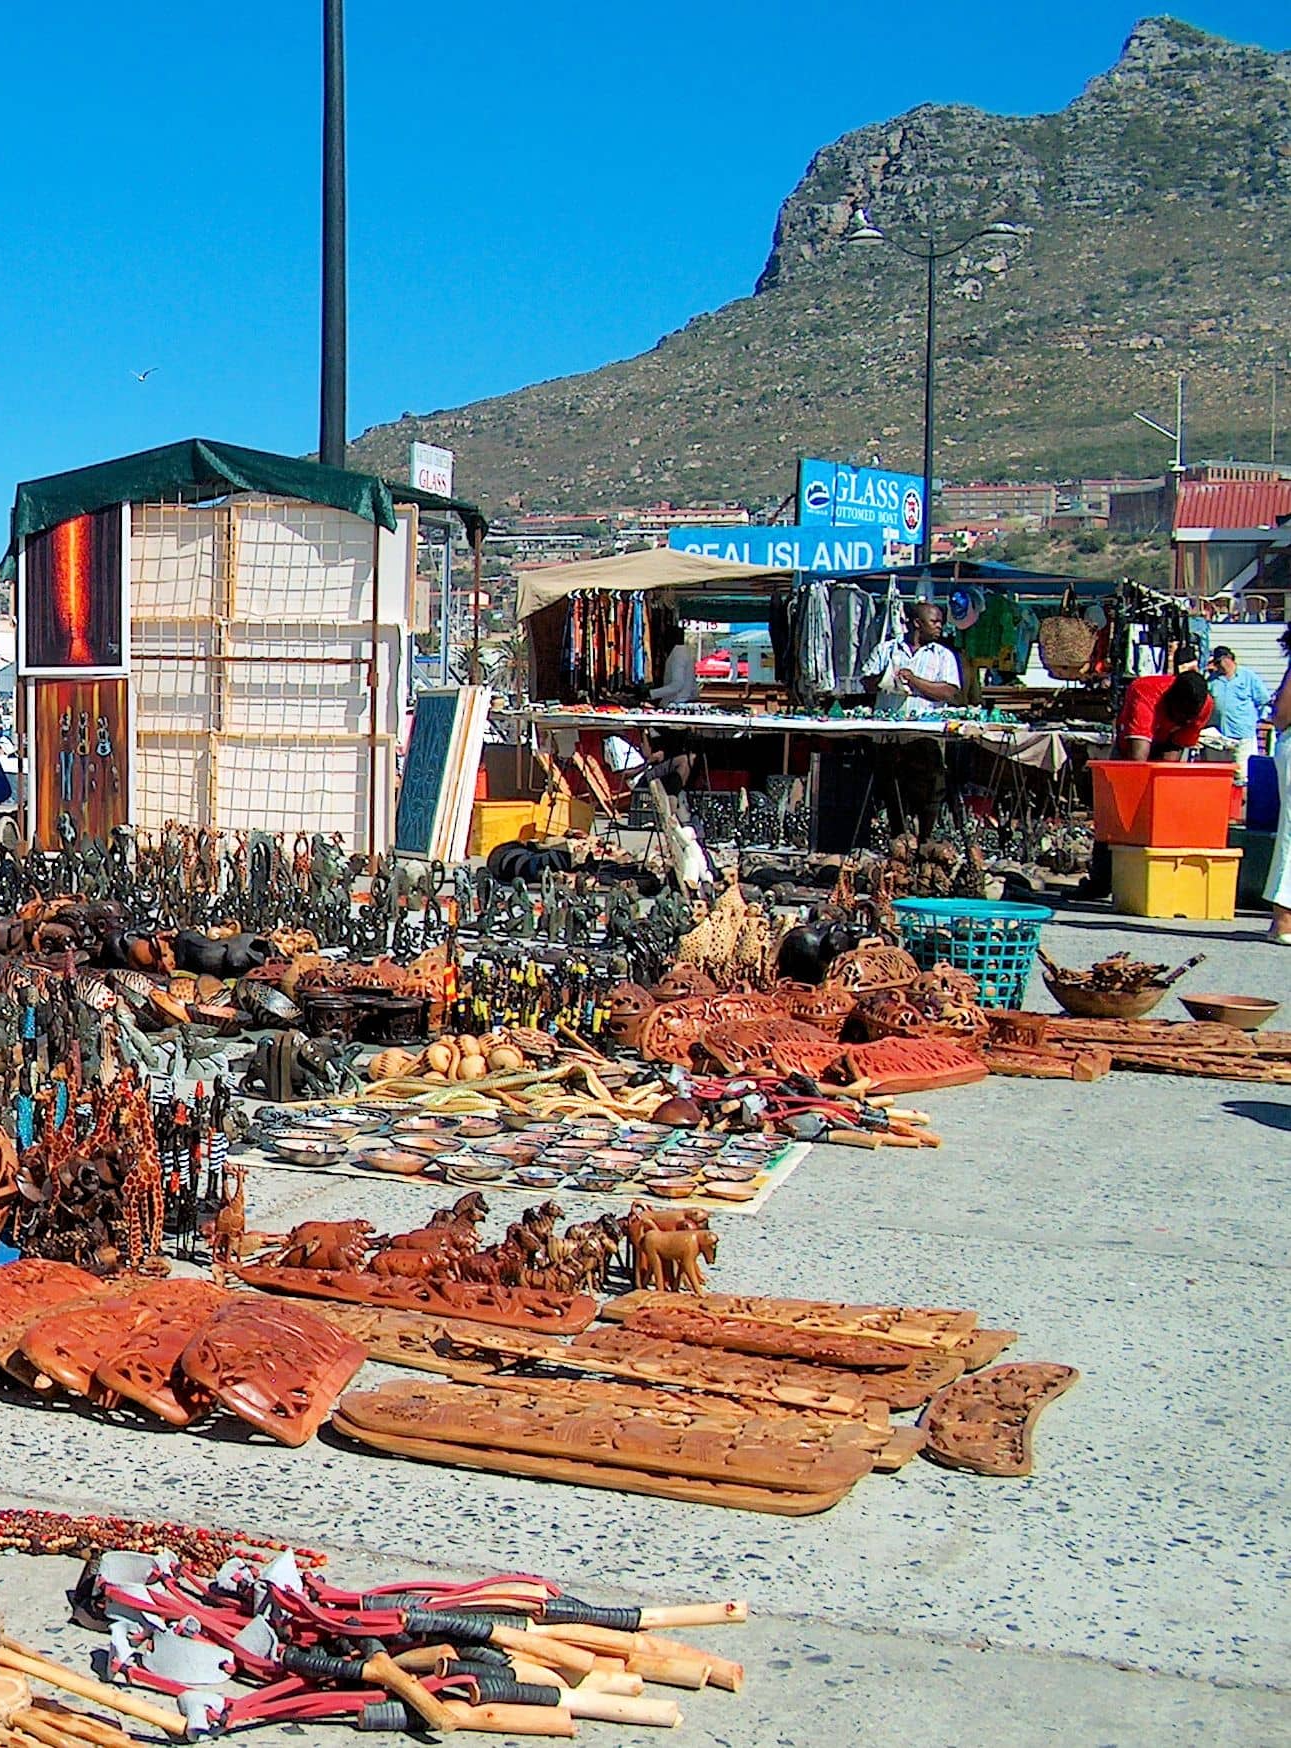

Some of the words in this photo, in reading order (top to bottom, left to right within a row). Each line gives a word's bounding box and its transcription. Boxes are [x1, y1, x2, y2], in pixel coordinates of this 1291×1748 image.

[419, 469, 446, 493] GLASS
[832, 471, 899, 510] GLASS
[878, 511, 899, 525] BOAT
[767, 541, 873, 571] ISLAND
